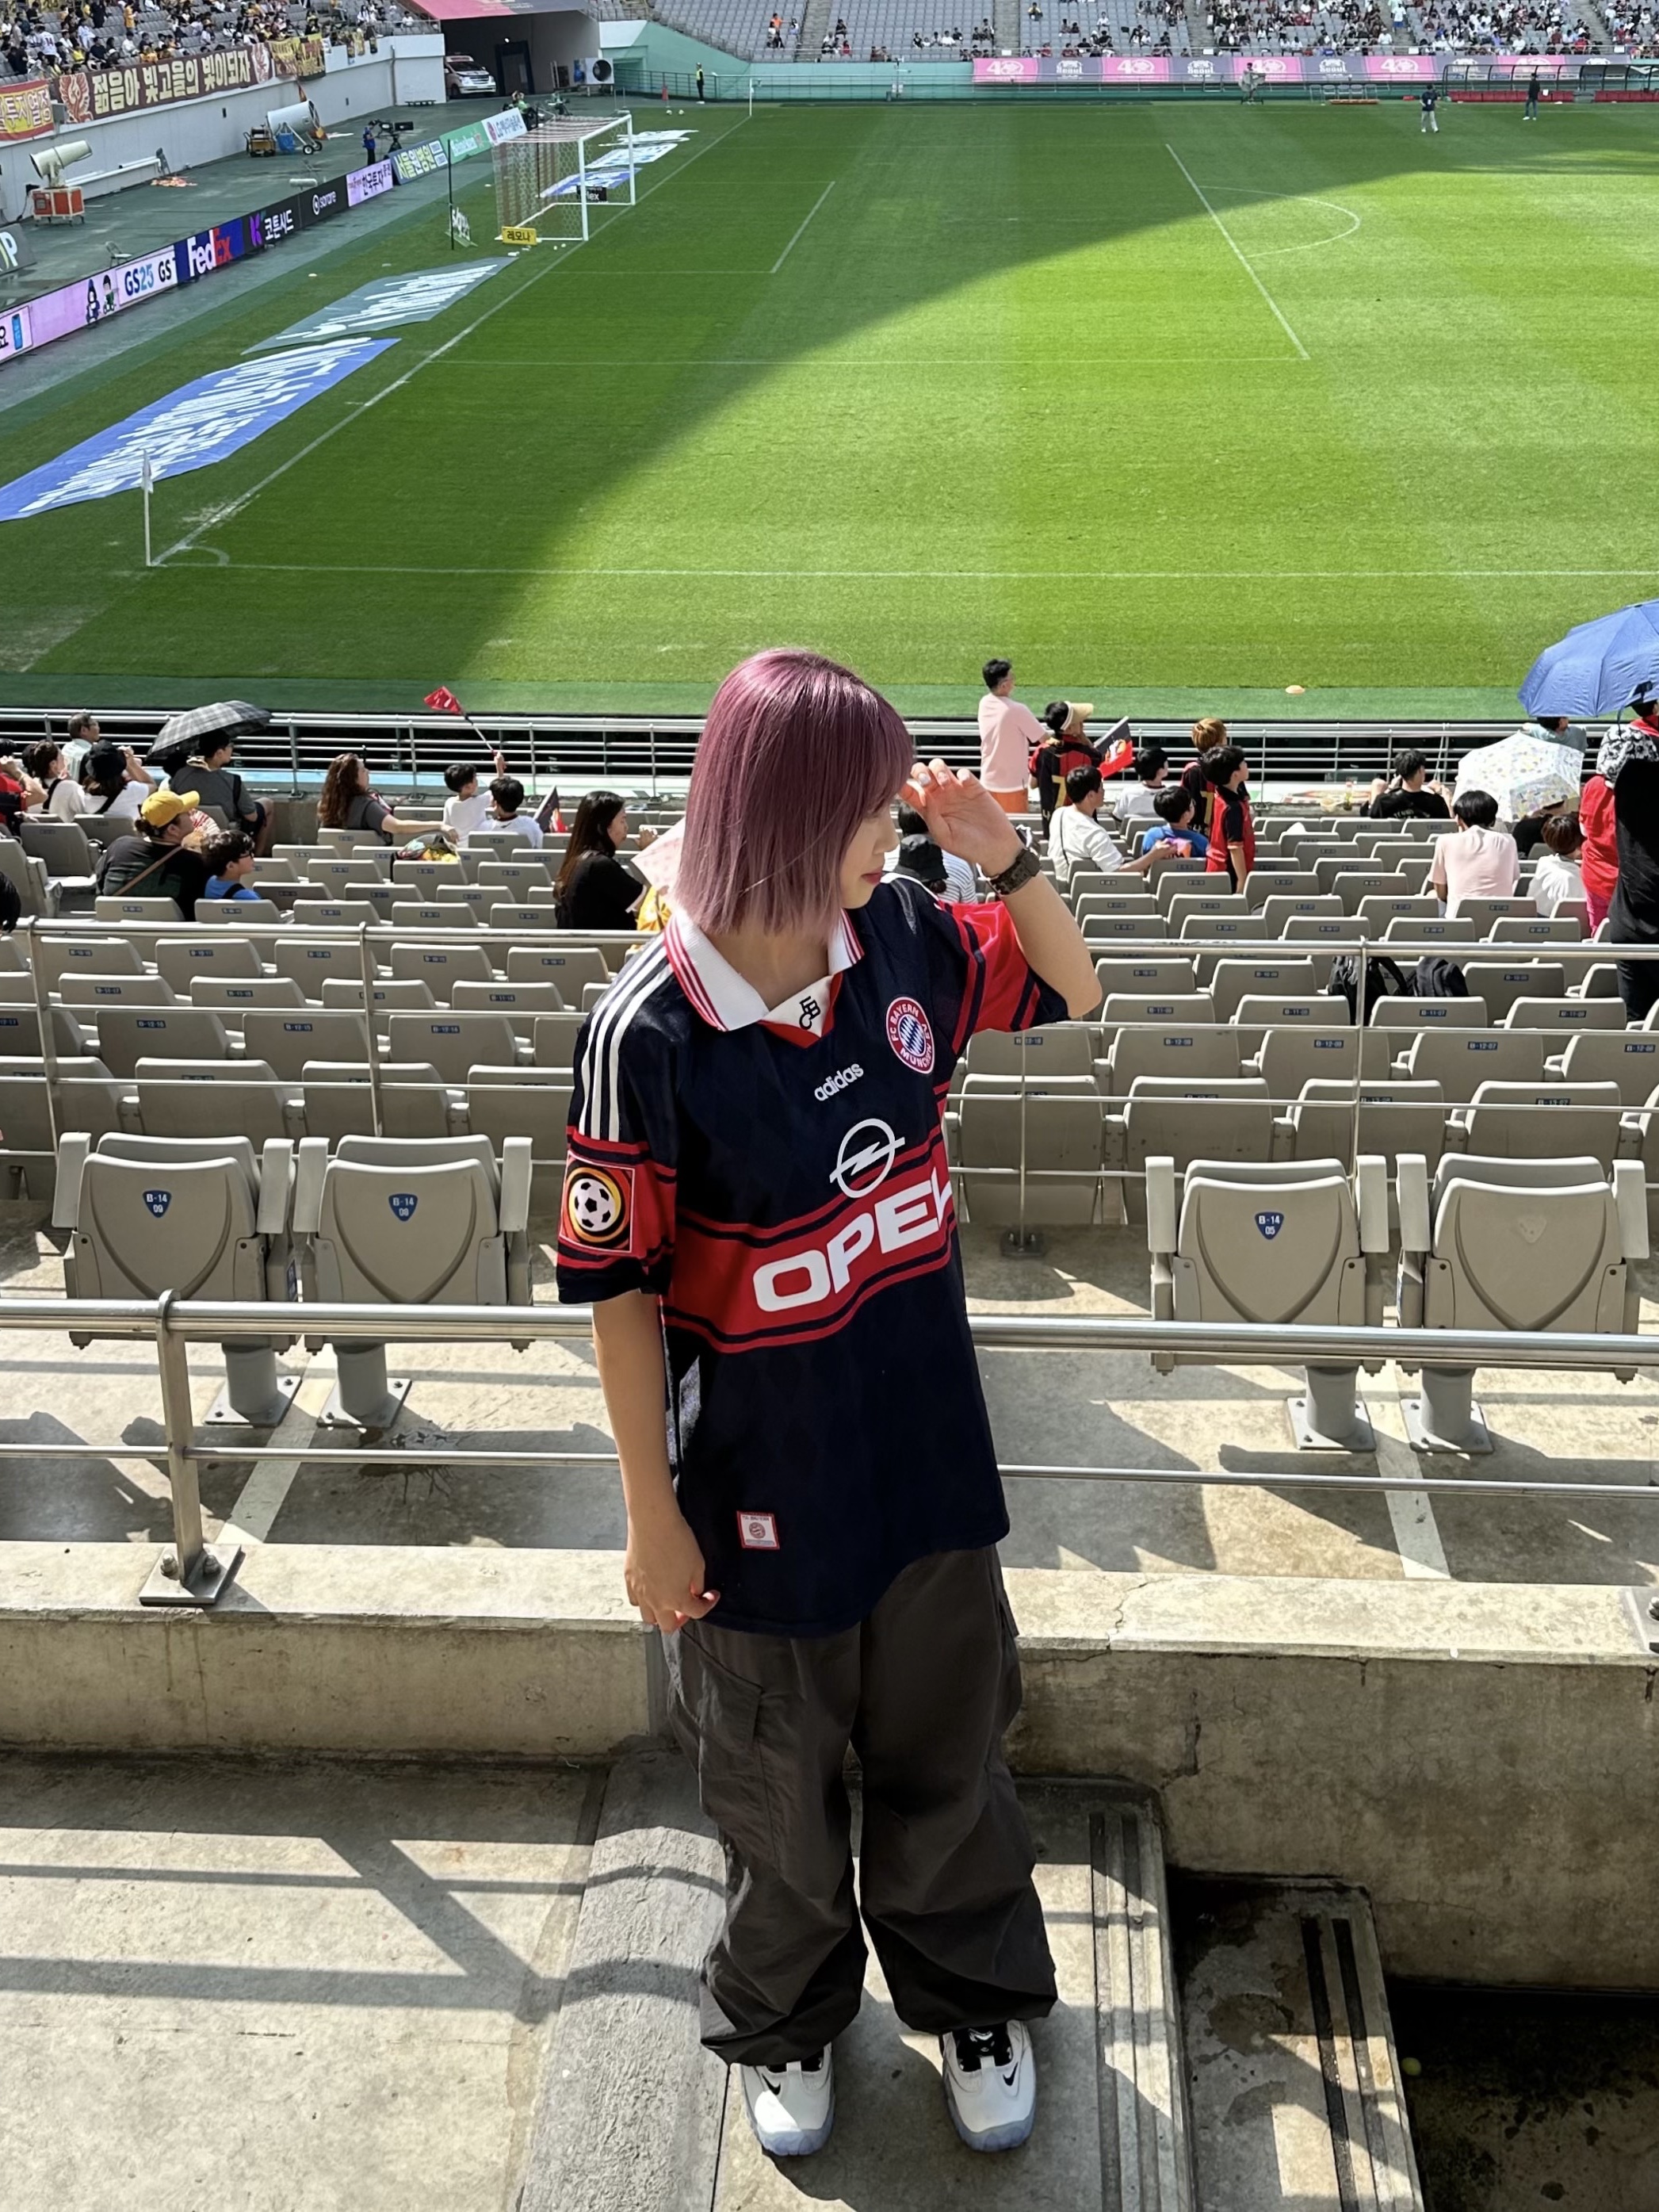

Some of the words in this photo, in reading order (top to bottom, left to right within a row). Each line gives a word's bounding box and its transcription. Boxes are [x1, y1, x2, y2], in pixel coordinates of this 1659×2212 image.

[92, 68, 141, 115] 젊음아
[143, 59, 199, 104] 빛고을의
[202, 49, 251, 92] 빛이되자
[506, 230, 530, 243] 레모나
[187, 228, 233, 277] FedEx
[124, 263, 154, 297] GS25
[889, 1003, 919, 1025] BAYERN
[889, 1027, 899, 1042] FC
[814, 1063, 864, 1102] adidas
[146, 1193, 167, 1203] B-14
[392, 1197, 414, 1207] B-14
[1259, 1215, 1280, 1225] B-14
